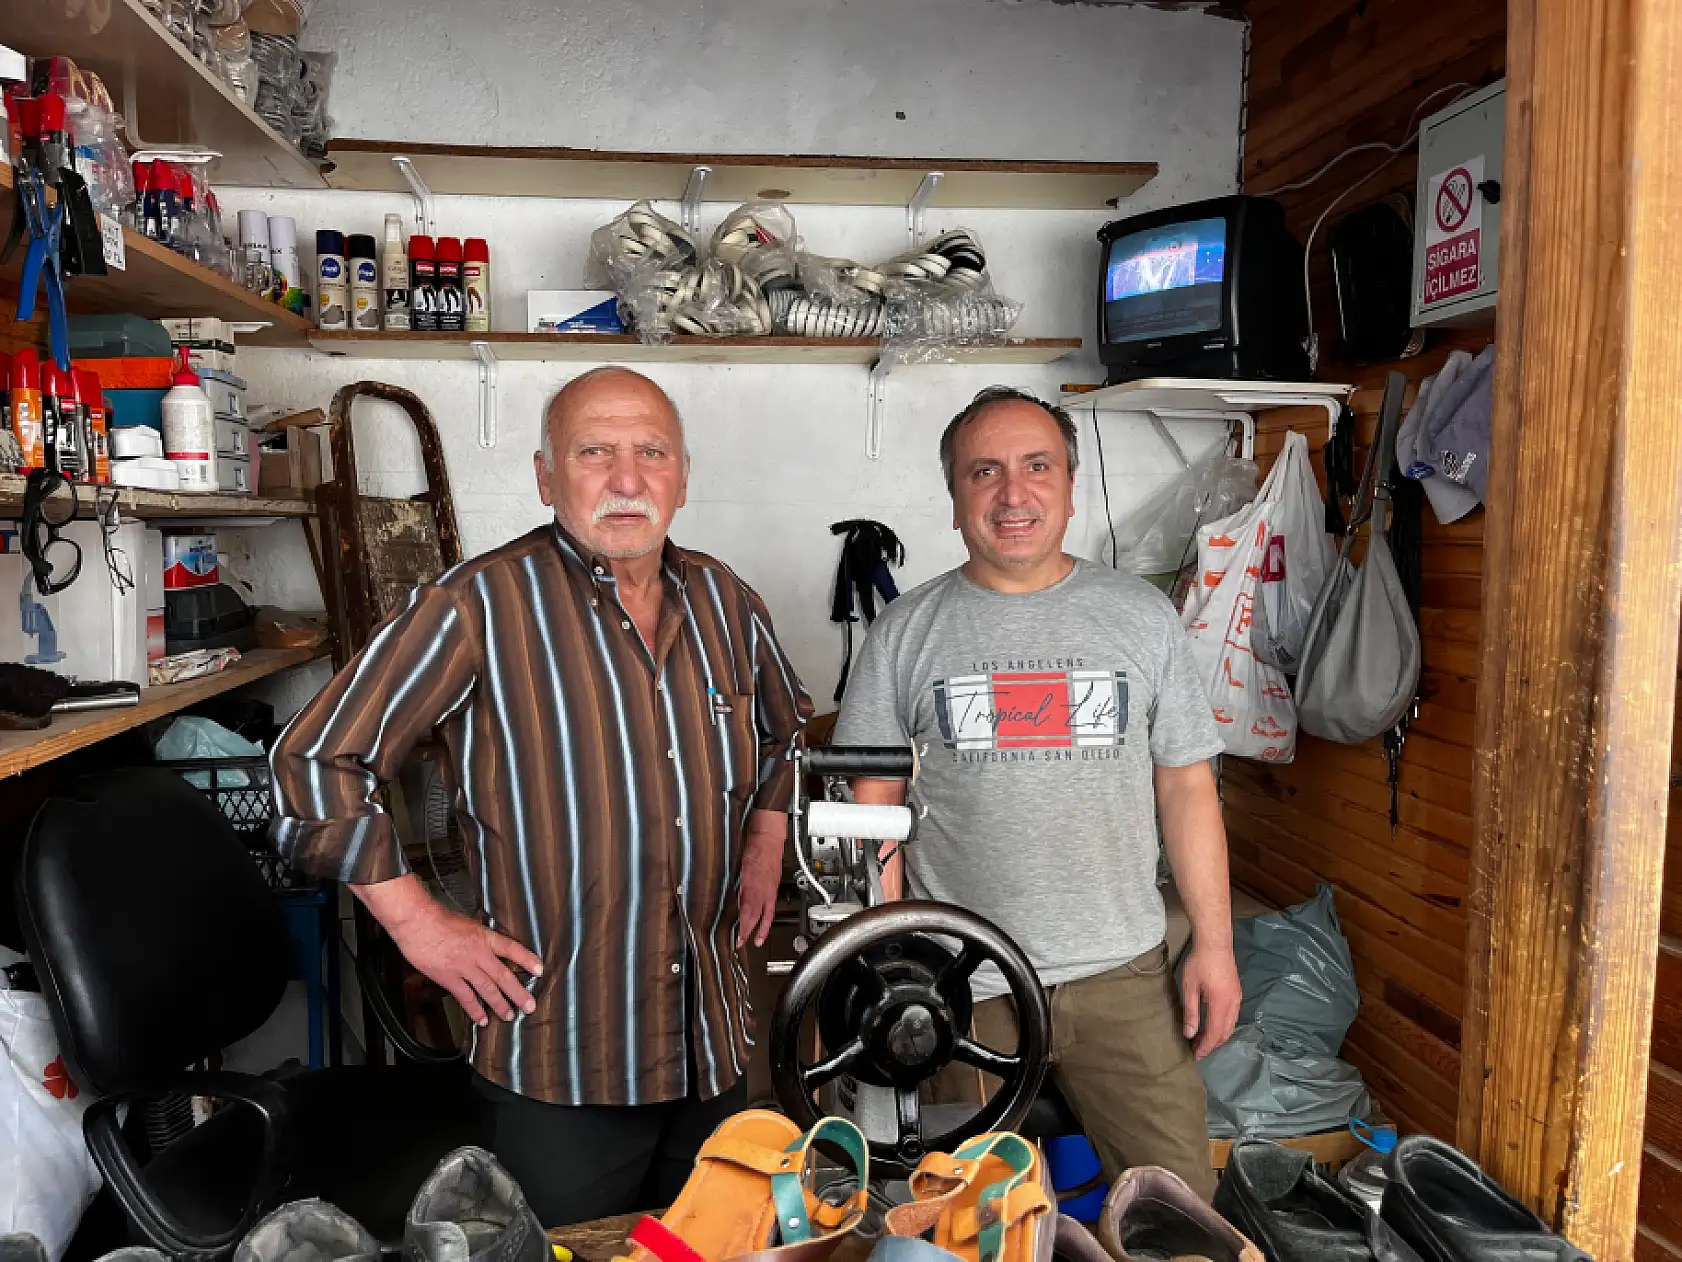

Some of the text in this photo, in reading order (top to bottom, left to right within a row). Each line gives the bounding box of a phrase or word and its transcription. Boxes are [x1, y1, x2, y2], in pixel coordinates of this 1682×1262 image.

[973, 660, 999, 672] LOS
[946, 681, 1120, 733] Tropical Life
[952, 749, 1120, 763] CALIFORNIA SAN DIEGO
